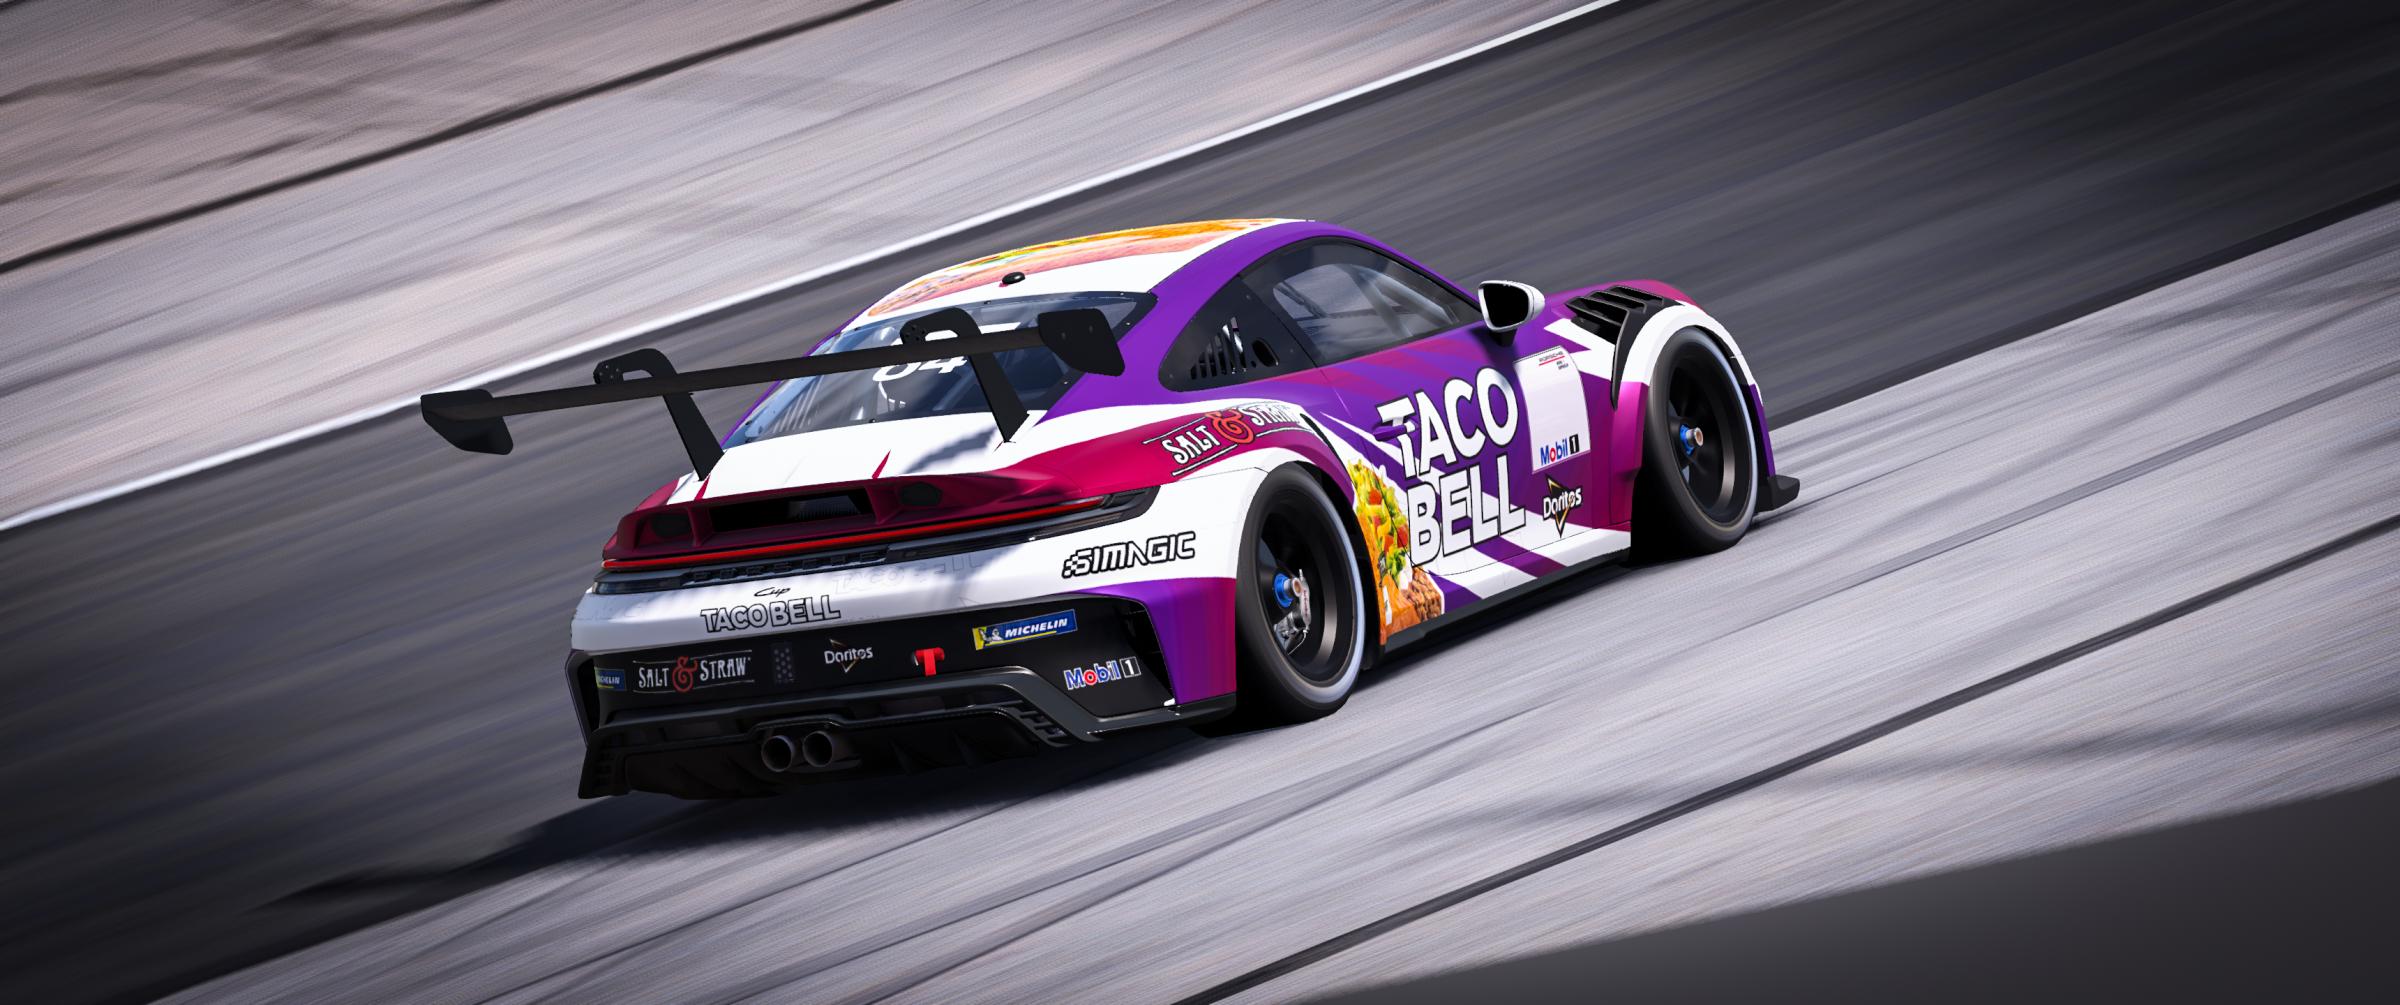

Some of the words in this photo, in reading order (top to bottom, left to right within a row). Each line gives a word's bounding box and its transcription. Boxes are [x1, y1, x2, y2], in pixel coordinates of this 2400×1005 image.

[1161, 425, 1221, 464] SALT
[1204, 408, 1255, 443] &
[1376, 367, 1518, 480] TACO
[1540, 438, 1568, 466] Mobil
[1570, 434, 1579, 454] 1
[1406, 454, 1526, 568] BELL
[1542, 486, 1583, 520] Doritos
[754, 586, 791, 597] Cup
[700, 603, 768, 633] TACO
[769, 594, 841, 627] BELL
[1004, 617, 1069, 639] MICHELIN
[824, 646, 873, 664] Doritos
[638, 667, 670, 688] SALT
[672, 656, 698, 692] &
[700, 657, 746, 681] STRAW
[1063, 660, 1122, 691] Mobil
